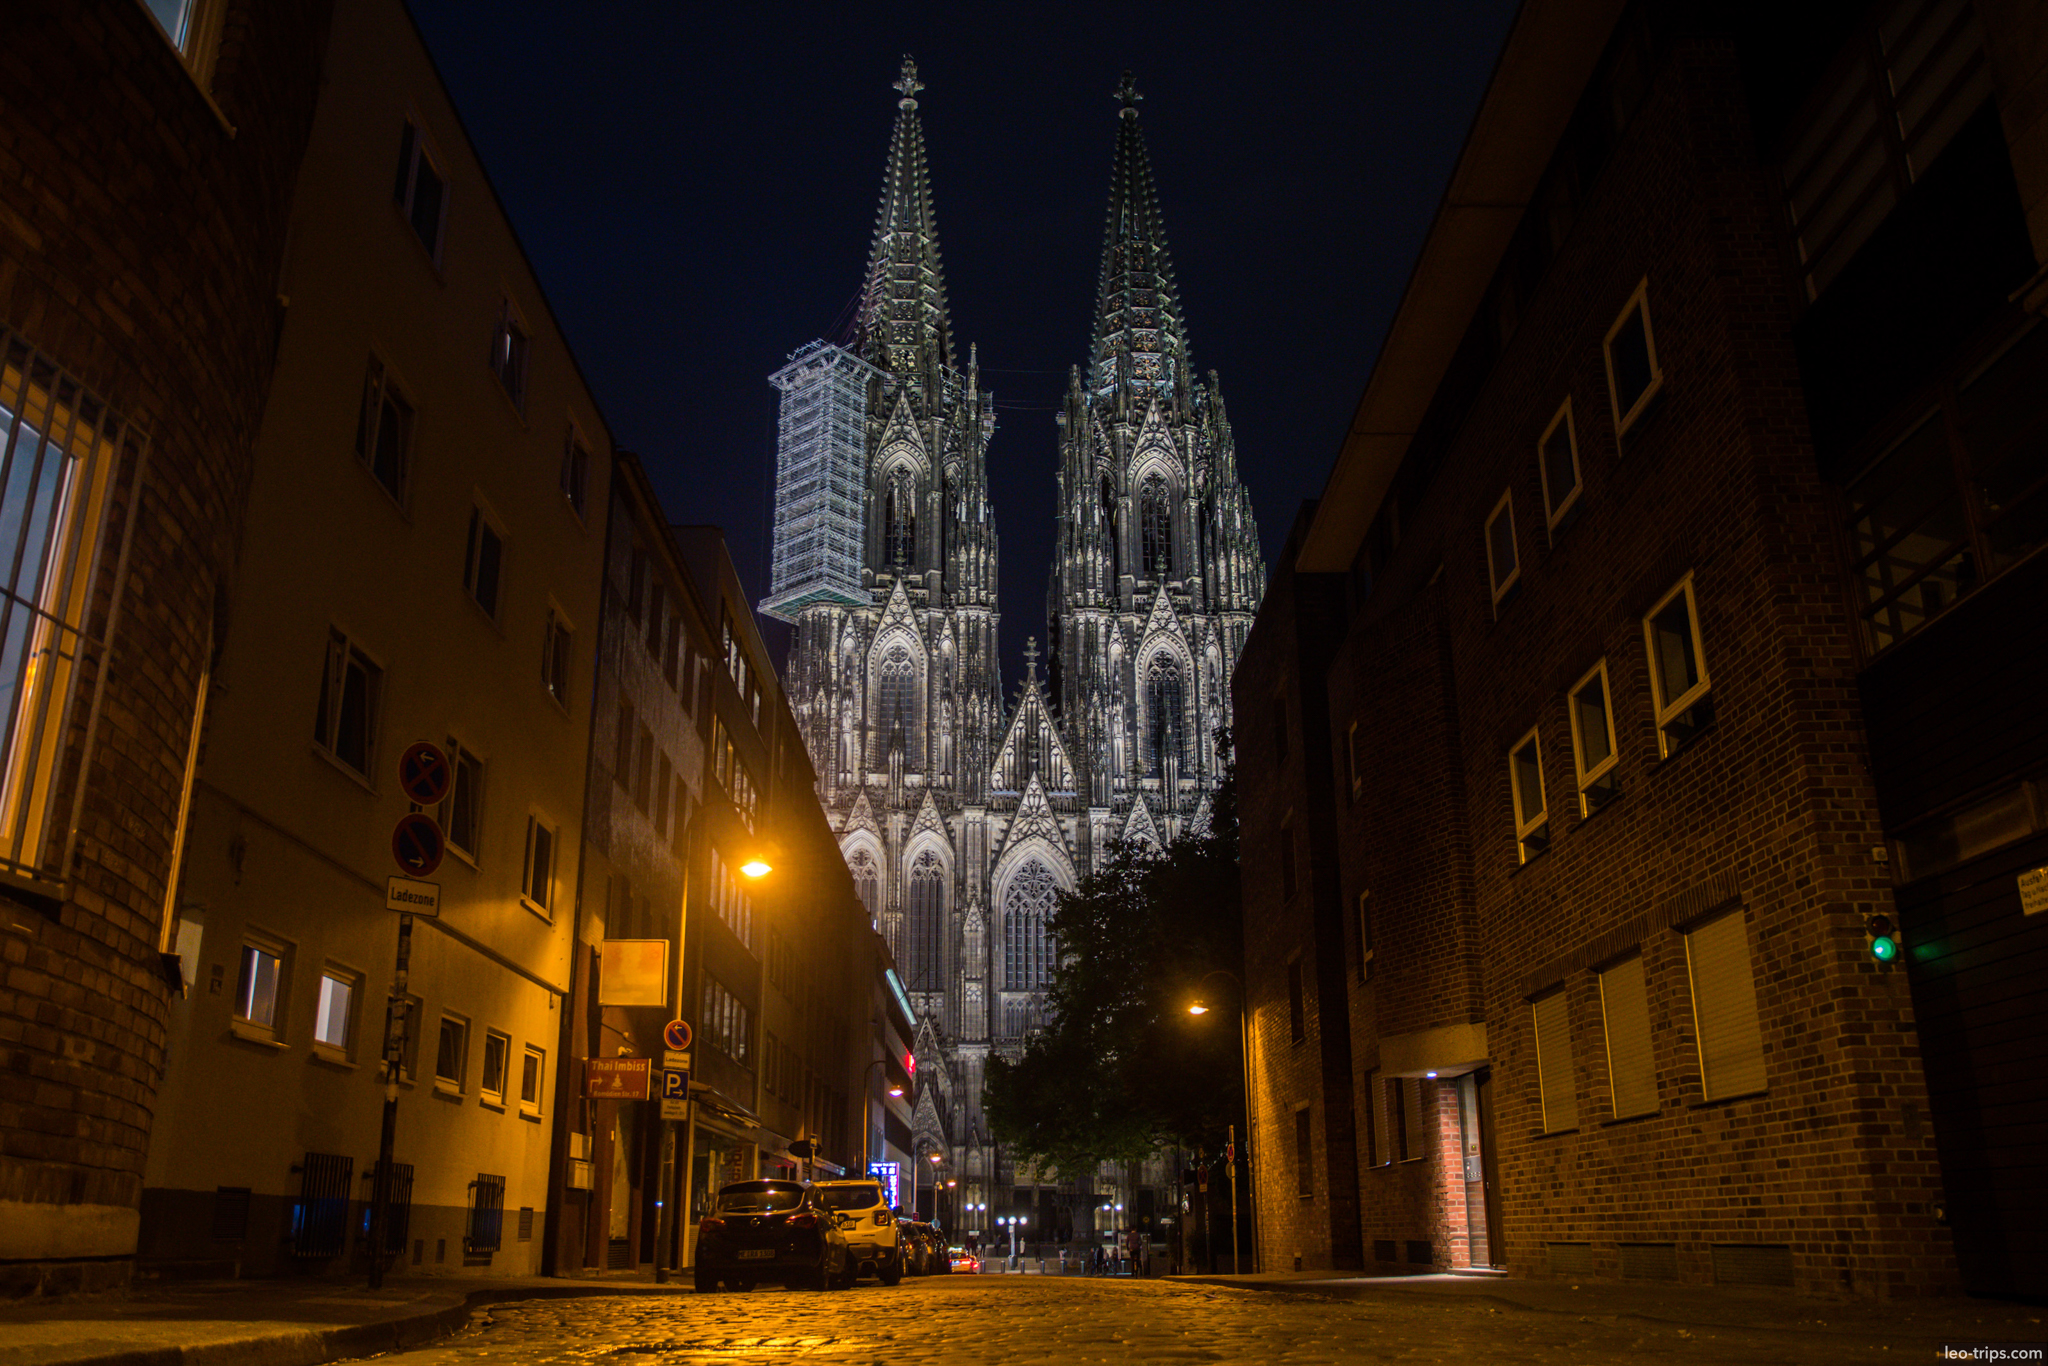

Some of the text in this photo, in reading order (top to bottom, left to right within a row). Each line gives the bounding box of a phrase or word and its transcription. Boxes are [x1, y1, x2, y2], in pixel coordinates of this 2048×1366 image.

[391, 887, 435, 907] Ladezone
[592, 1060, 646, 1072] Thai Imbiss
[666, 1073, 681, 1096] P
